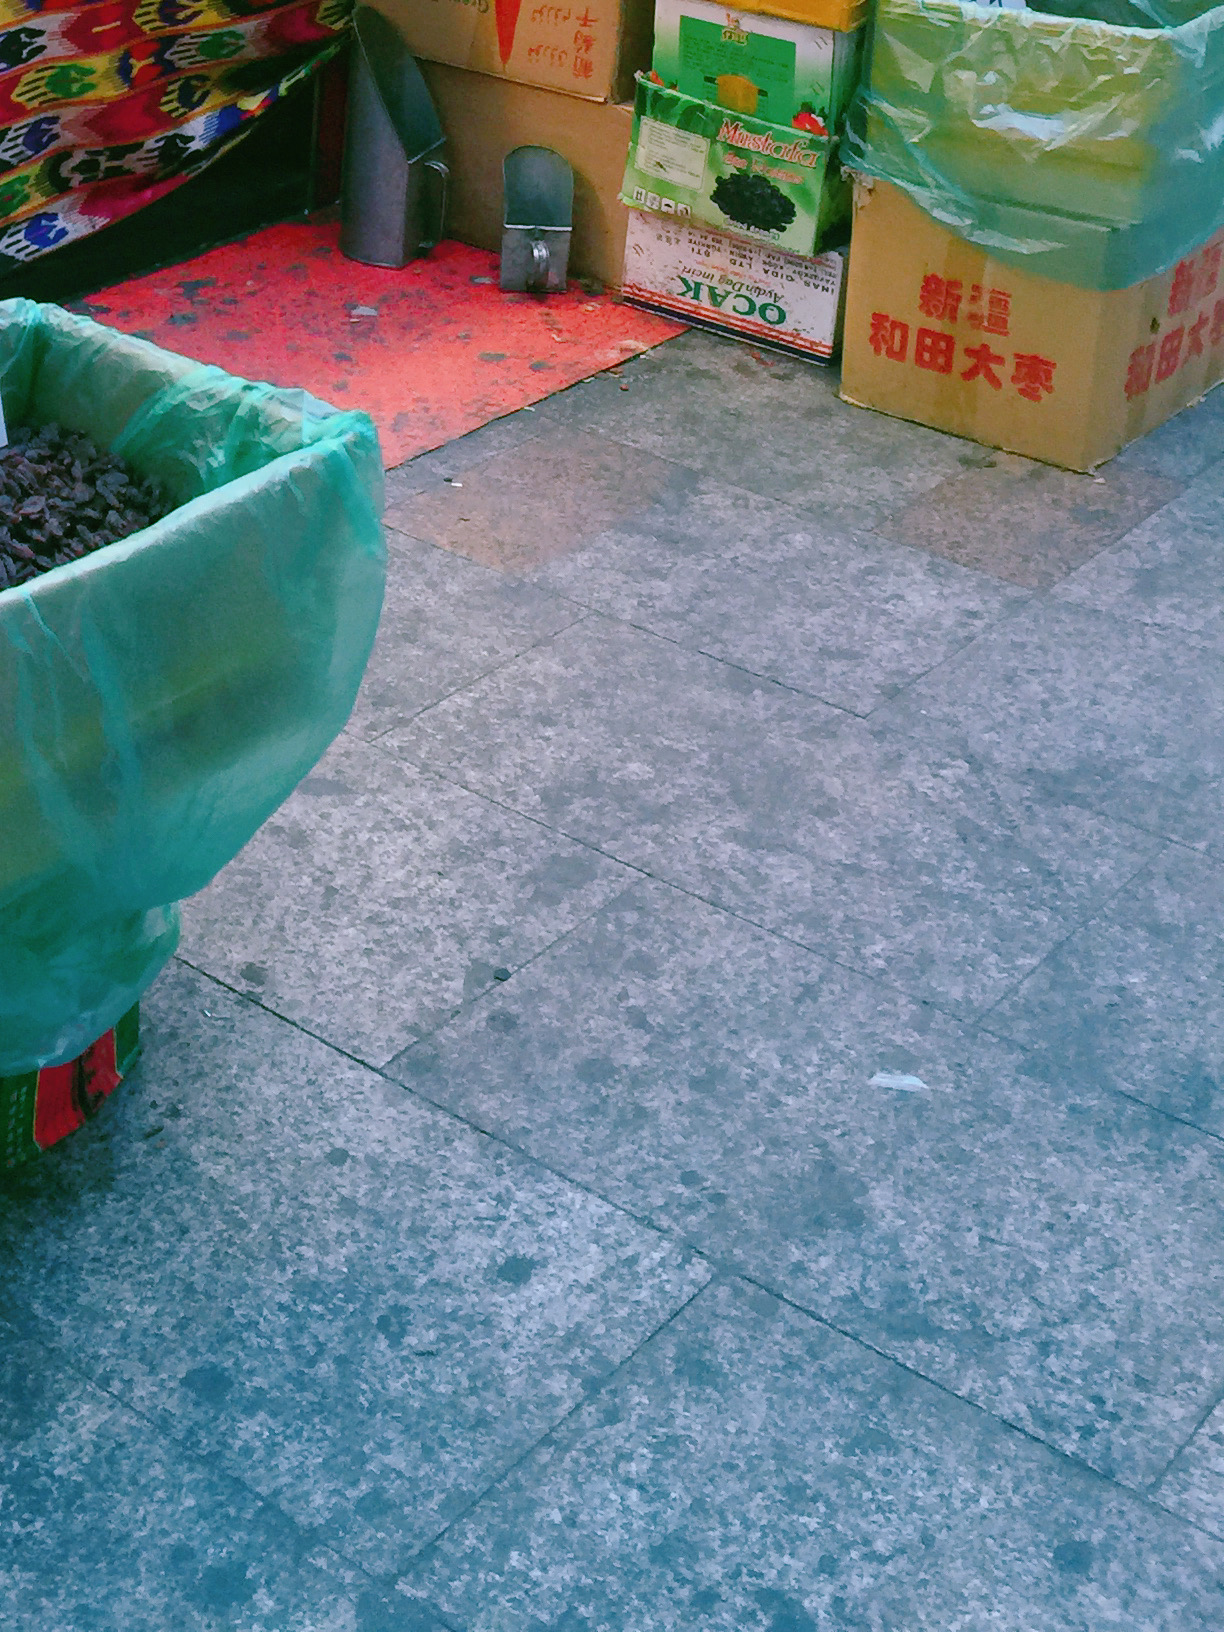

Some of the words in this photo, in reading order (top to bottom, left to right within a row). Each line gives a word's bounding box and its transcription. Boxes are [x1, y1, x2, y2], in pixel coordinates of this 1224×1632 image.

[716, 118, 821, 168] Mustafa
[677, 275, 787, 326] OCAK
[919, 273, 1012, 337] 新疆
[869, 312, 1057, 403] 和田大枣
